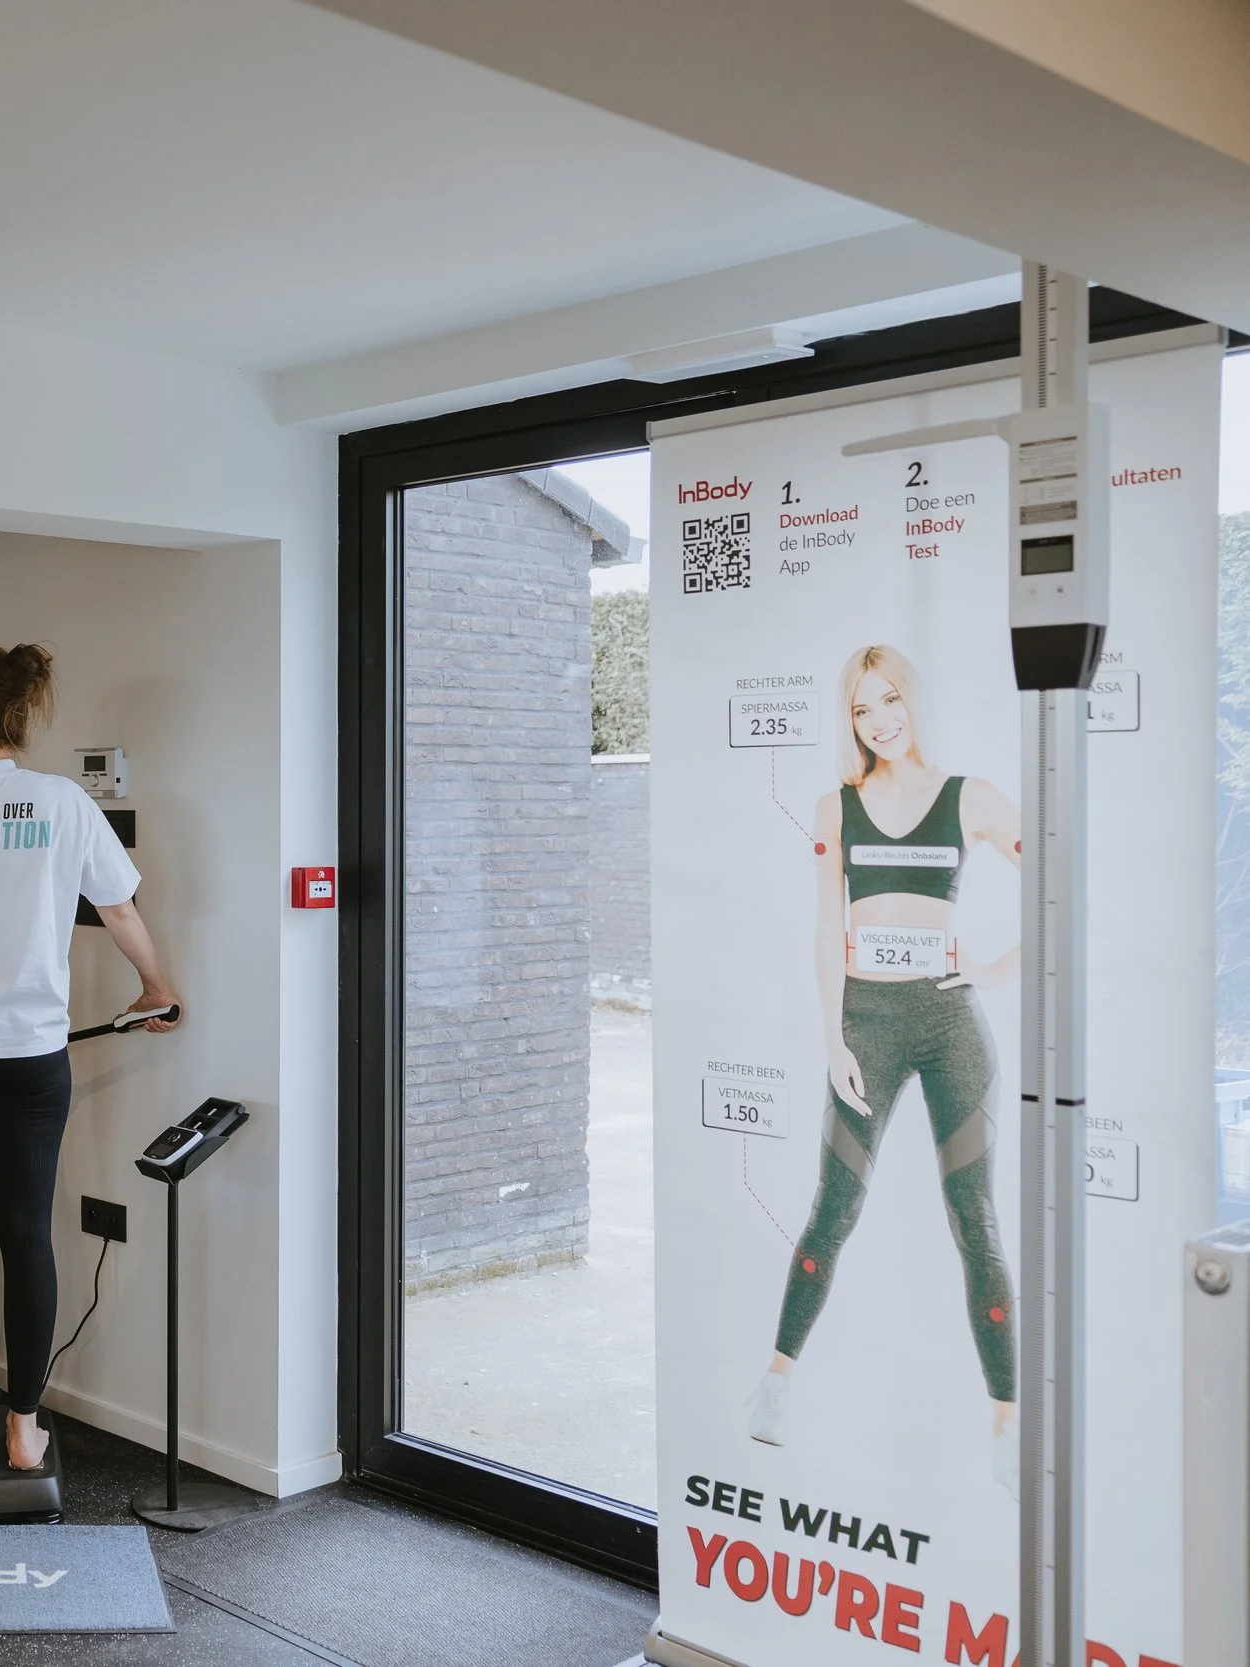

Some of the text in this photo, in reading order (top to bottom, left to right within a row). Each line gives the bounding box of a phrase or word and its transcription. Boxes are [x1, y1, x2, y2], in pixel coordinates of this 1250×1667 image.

[905, 461, 929, 488] 2.
[1111, 467, 1181, 487] ultaten
[678, 475, 753, 504] InBody
[780, 480, 801, 505] 1.
[906, 493, 975, 512] Doe een
[779, 505, 859, 529] Download
[906, 515, 965, 536] InBody
[779, 529, 856, 551] de InBody
[905, 543, 940, 560] Test
[779, 559, 811, 577] App
[1099, 652, 1123, 664] RM
[736, 675, 813, 689] RECHTER ARM
[741, 701, 809, 714] SPIERMASSA
[750, 718, 803, 736] 2.35 kg
[3, 802, 34, 819] OVER
[911, 851, 947, 860] Onbalans
[860, 932, 943, 947] VISCERAAL VET
[875, 948, 912, 966] 52.4
[707, 1060, 785, 1080] RECHTER BEEN
[718, 1087, 774, 1104] VETMASSA
[723, 1103, 773, 1128] 1.50 kg
[684, 1474, 931, 1566] SEE WHAT
